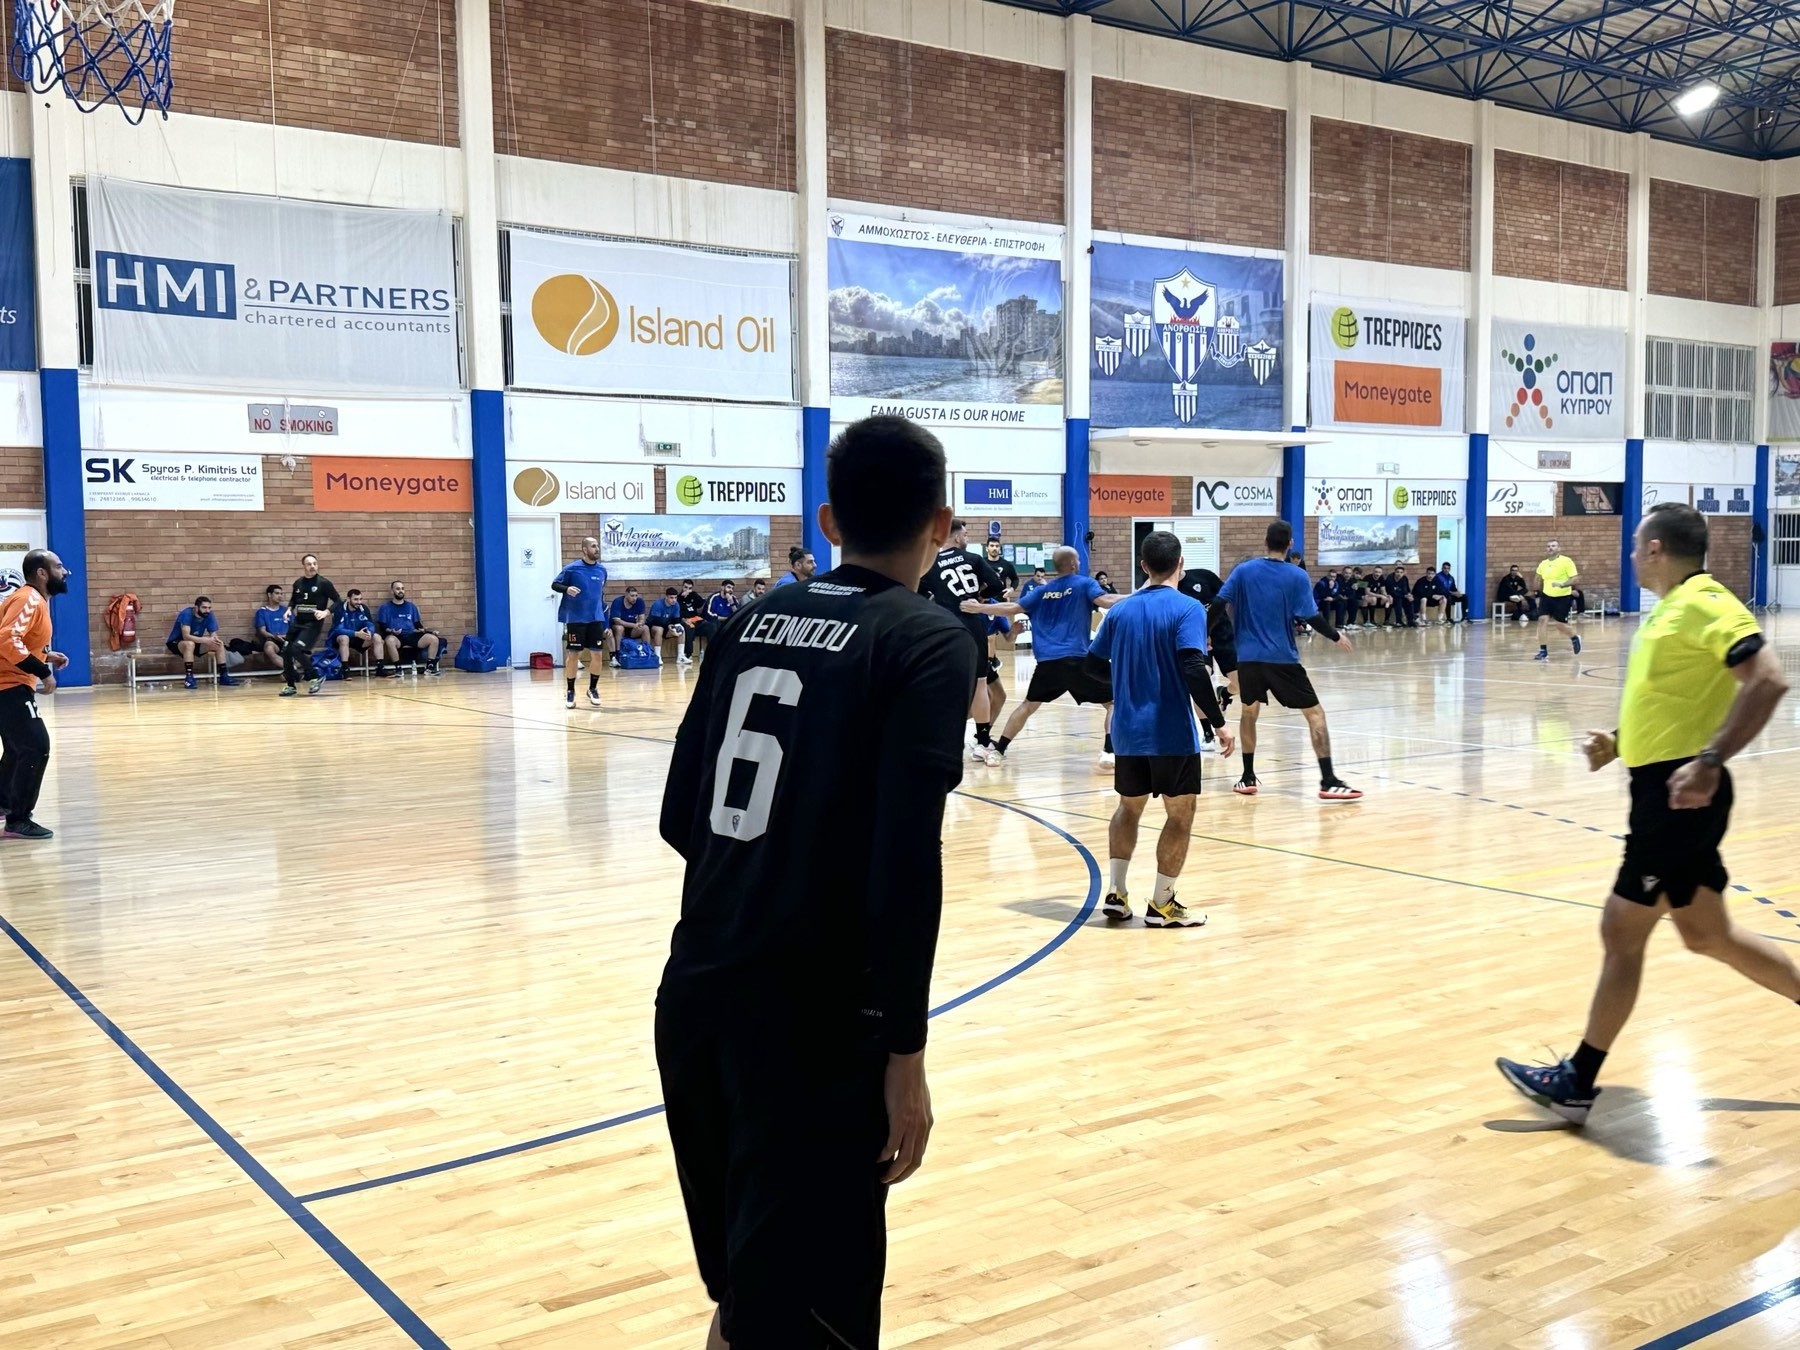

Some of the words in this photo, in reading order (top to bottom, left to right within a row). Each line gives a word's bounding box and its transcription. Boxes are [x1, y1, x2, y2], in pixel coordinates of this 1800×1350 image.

[936, 233, 987, 247] ΕΛΕΥΘΕΡΙΑ
[994, 238, 1045, 252] ΕΠΙΣΤΡΟΦΗ
[106, 258, 227, 313] HMI
[244, 278, 261, 301] &
[270, 280, 450, 312] PARTNERS
[244, 311, 337, 330] chartered
[344, 318, 451, 334] accountants
[629, 305, 723, 350] Island
[737, 316, 775, 352] Oil
[1363, 316, 1442, 351] TREPPIDES
[1344, 380, 1432, 406] Moneygate
[950, 408, 960, 420] IS
[963, 409, 989, 421] OUR
[991, 409, 1025, 422] HOME
[1560, 398, 1613, 416] ΚΥΠΡΟΥ
[254, 418, 272, 431] NO
[280, 419, 333, 433] SMOKING
[85, 457, 136, 484] SK
[141, 463, 181, 476] Spyros
[198, 464, 238, 475] Kimitris
[240, 466, 257, 475] Ltd
[188, 475, 217, 483] telephone
[326, 472, 459, 495] Moneygate
[565, 481, 616, 501] Island
[622, 481, 644, 501] Oil
[707, 481, 786, 503] TREPPIDES
[988, 488, 1009, 499] HMI
[1013, 490, 1020, 498] &
[1020, 490, 1048, 498] Partners
[1234, 486, 1274, 500] COSMA
[1089, 487, 1165, 504] Moneygate
[1411, 490, 1457, 506] TREPPIDES
[1504, 501, 1524, 514] SSP
[940, 563, 979, 597] 26
[740, 613, 859, 652] LEONIDOU
[709, 665, 804, 842] 6
